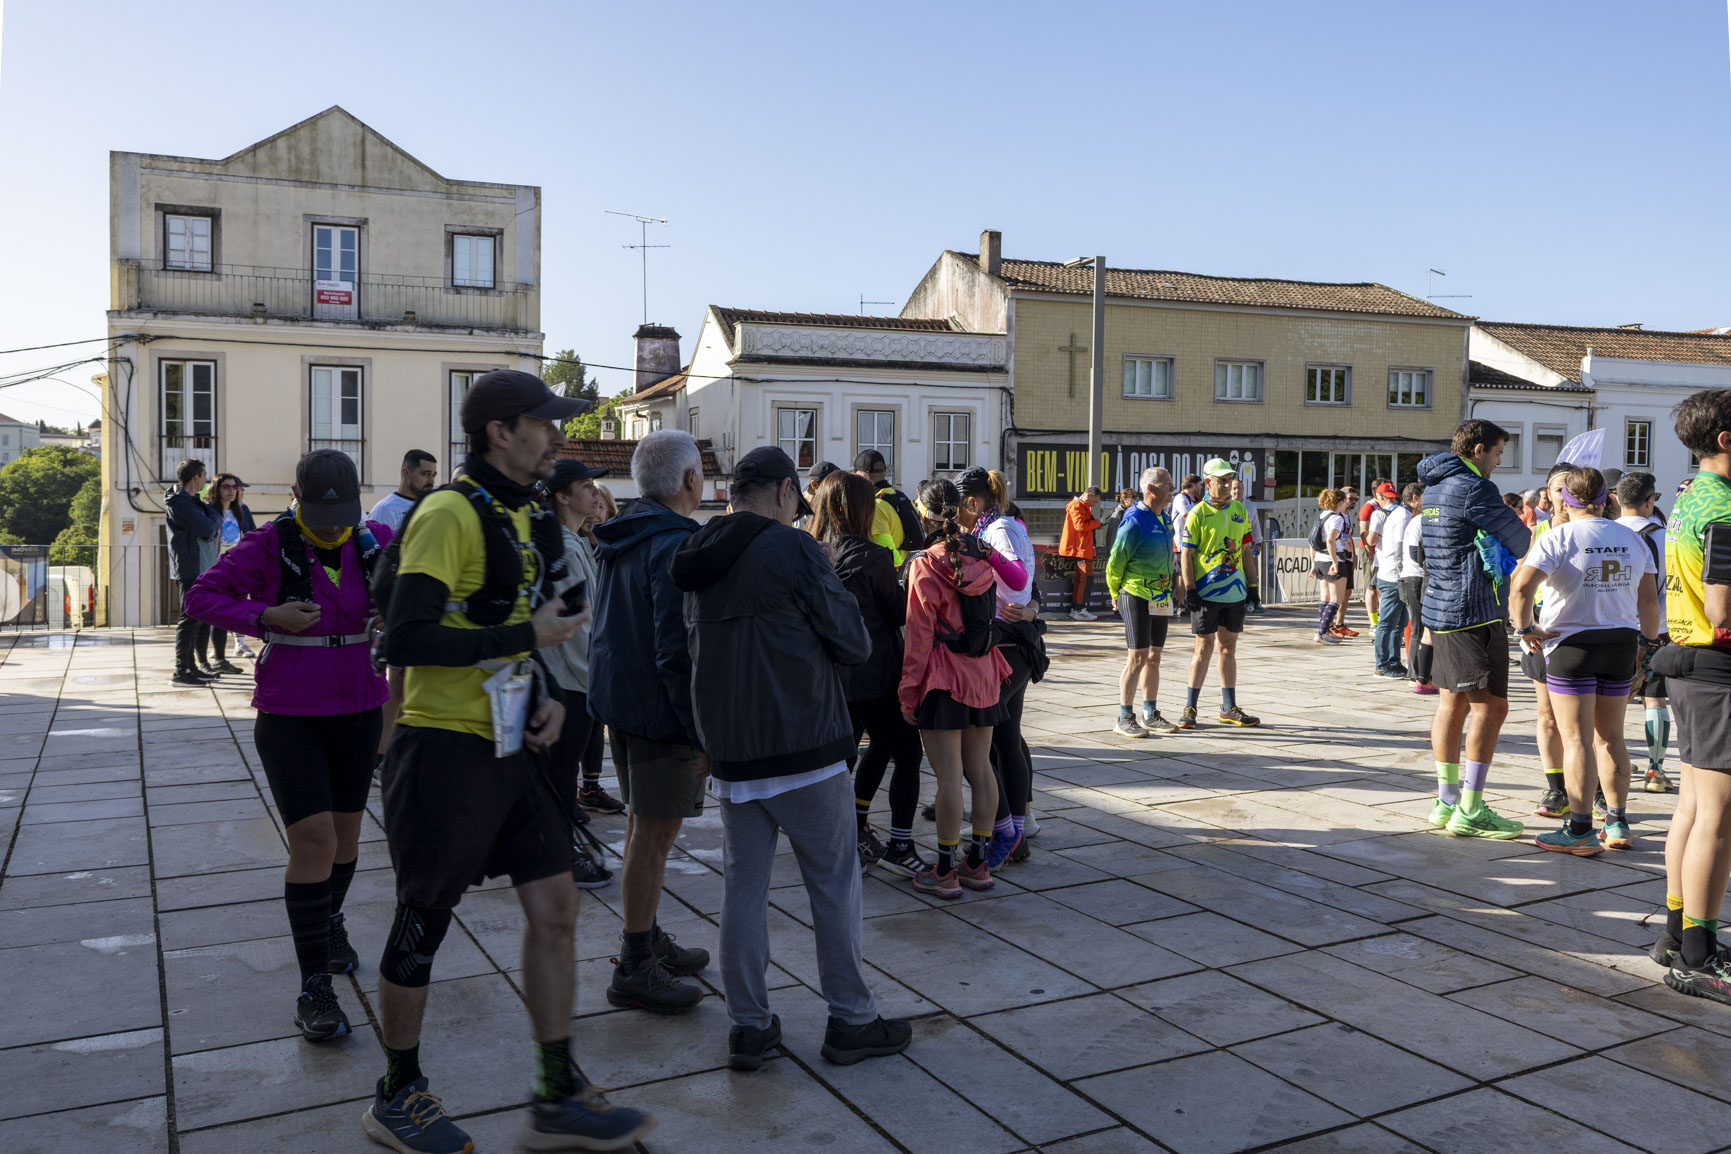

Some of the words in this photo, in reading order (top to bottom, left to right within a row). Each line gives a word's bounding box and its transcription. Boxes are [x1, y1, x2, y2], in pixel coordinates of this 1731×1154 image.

[1026, 450, 1109, 493] BEM-VINO
[1115, 445, 1124, 493] À
[1277, 556, 1312, 574] ACAD
